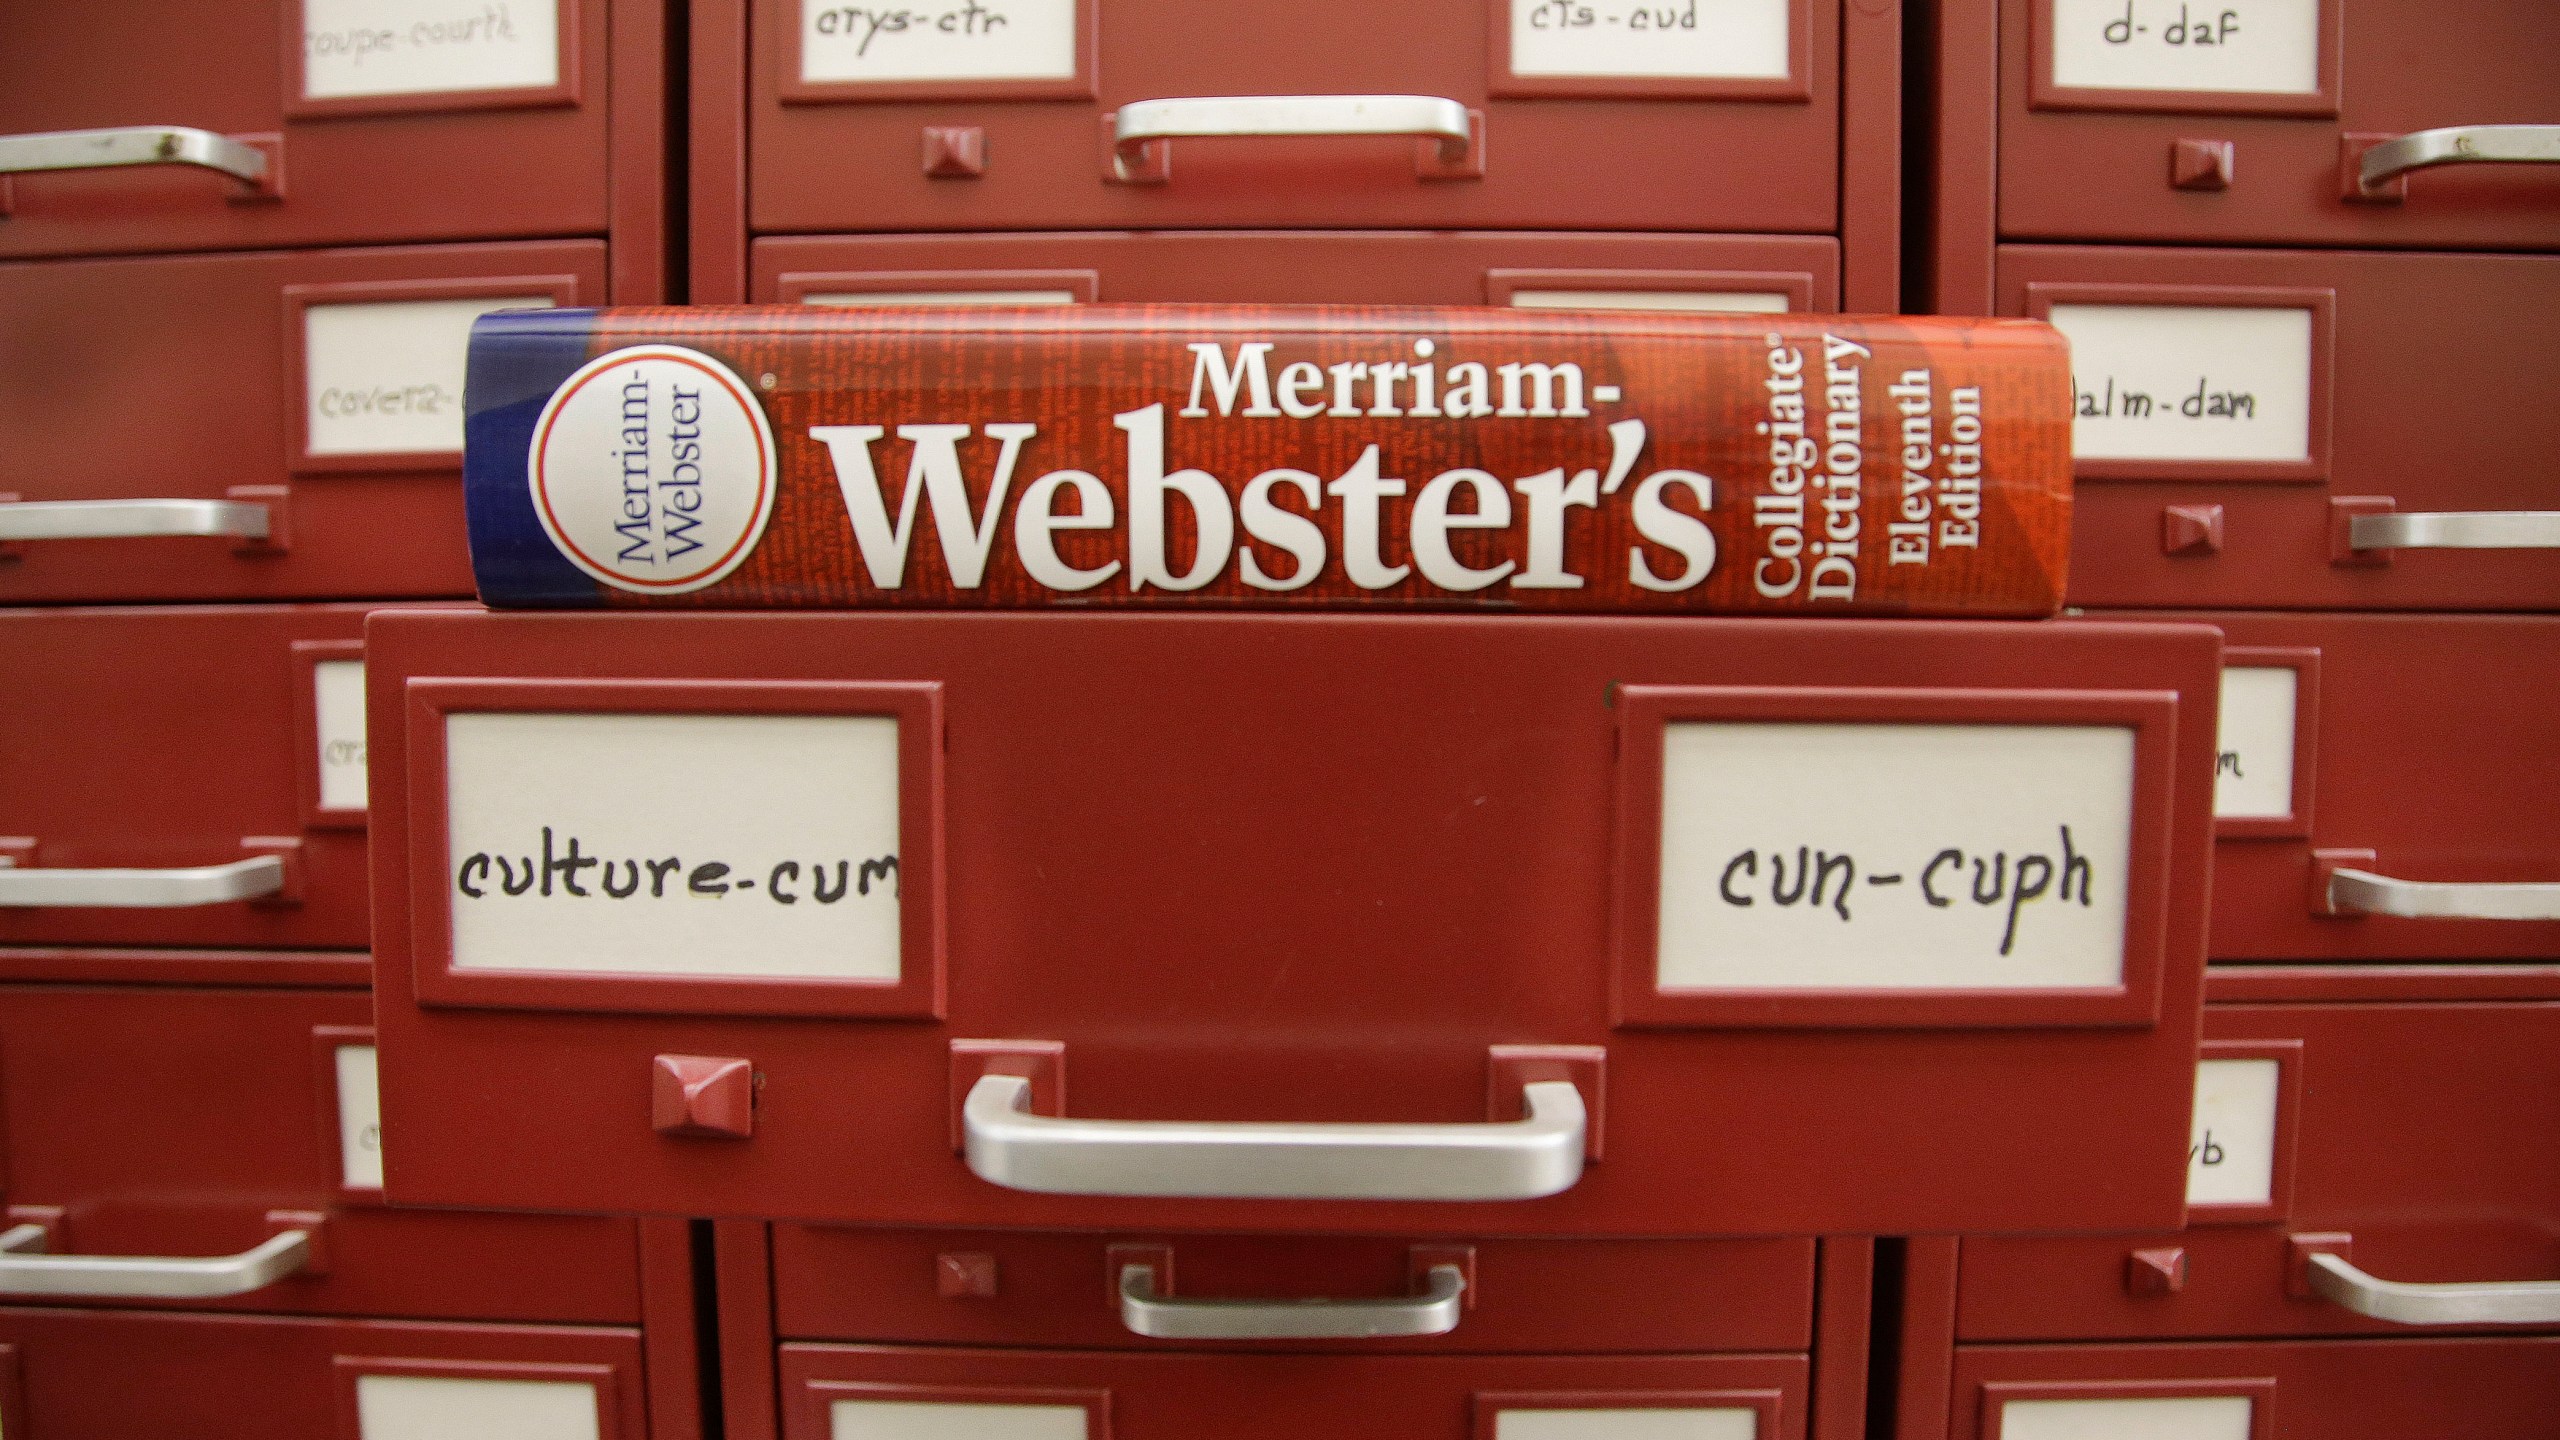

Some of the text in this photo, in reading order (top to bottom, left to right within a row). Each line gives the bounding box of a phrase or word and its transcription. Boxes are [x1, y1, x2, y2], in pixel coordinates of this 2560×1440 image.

[1179, 338, 1621, 419] Merriam-
[2072, 374, 2256, 419] alm-dam
[613, 369, 656, 566] Merriam-
[658, 384, 704, 564] Webster
[808, 402, 1717, 593] Webster's
[1808, 333, 1871, 602] Dictionary
[1888, 368, 1933, 567] Eleventh
[1938, 386, 1982, 550] Edition
[458, 825, 899, 906] culture-cum
[1719, 824, 2093, 956] cun-cuph
